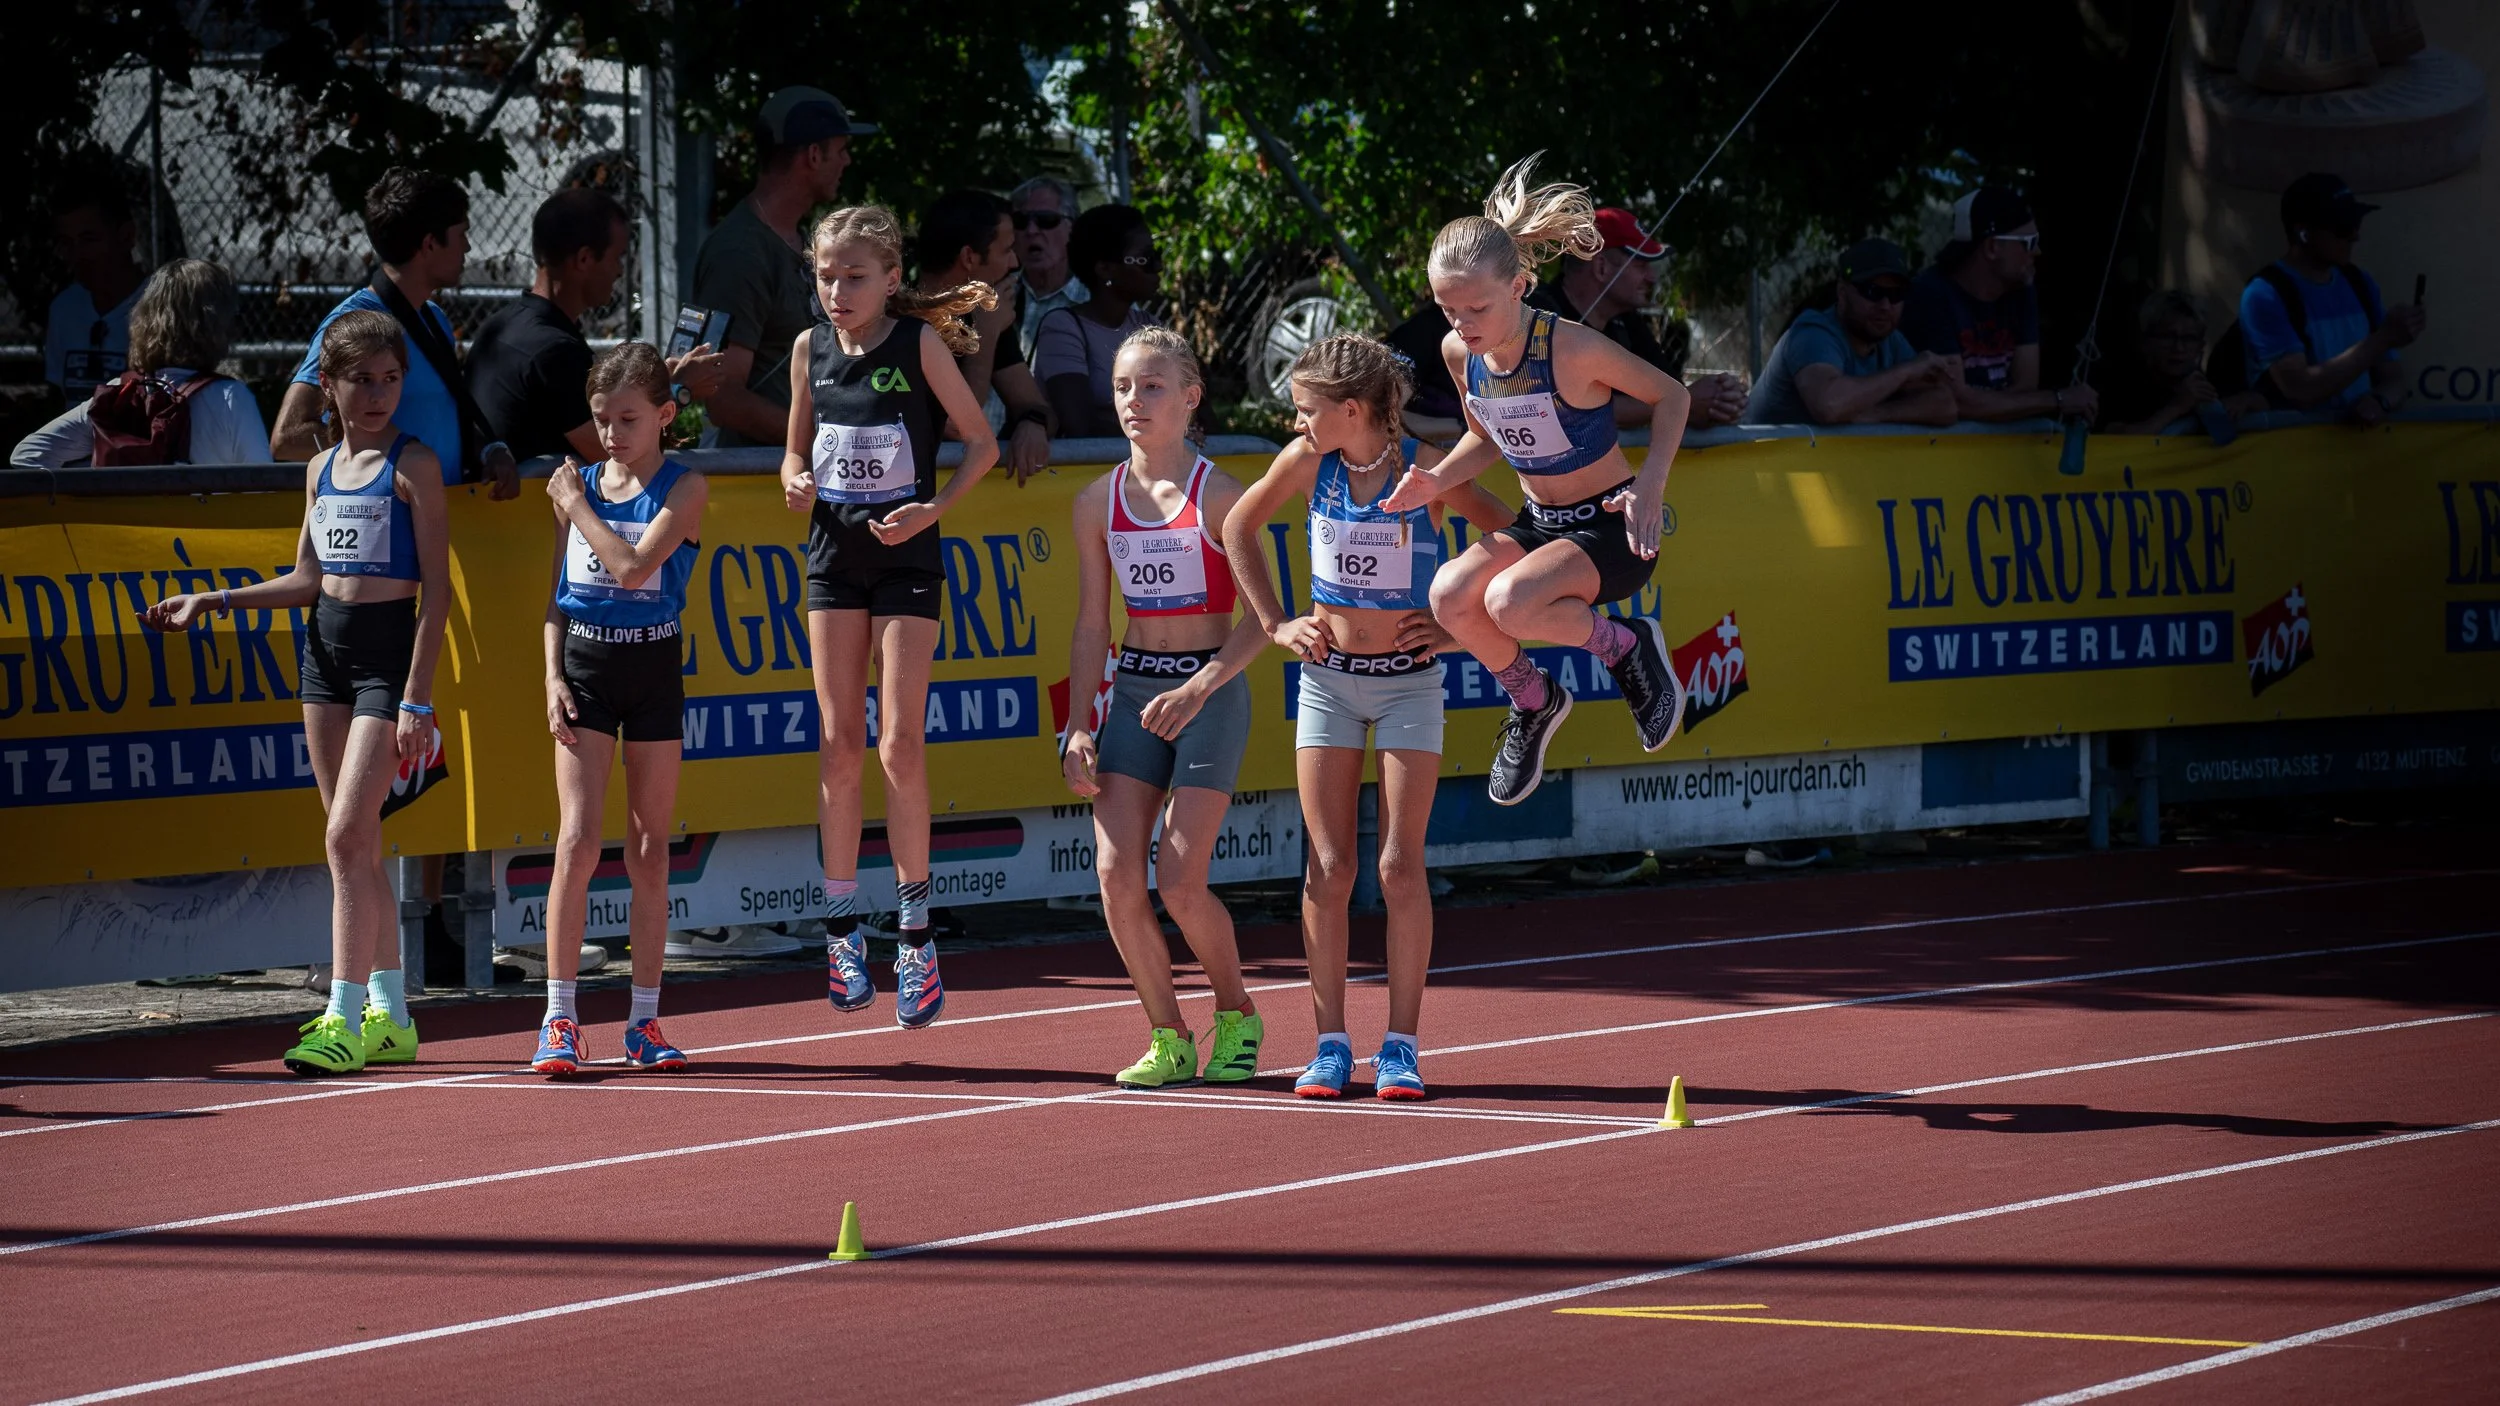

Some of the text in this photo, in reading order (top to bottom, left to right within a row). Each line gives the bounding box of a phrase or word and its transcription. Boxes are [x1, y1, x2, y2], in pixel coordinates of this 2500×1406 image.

[871, 366, 912, 393] CA
[2408, 365, 2500, 400] .co
[1496, 427, 1536, 447] 166
[836, 457, 885, 480] 336
[1543, 503, 1596, 525] PRO
[326, 528, 359, 549] 122
[1877, 465, 2236, 610] LE GRUYÈRE
[1129, 562, 1176, 585] 206
[1334, 552, 1378, 577] 162
[1340, 577, 1371, 587] KOHLER
[1905, 621, 2219, 673] SWITZERLAND
[2249, 616, 2312, 680] AOP
[1138, 656, 1200, 674] PRO
[1349, 654, 1414, 673] PRO
[1686, 646, 1745, 711] AOP
[2185, 754, 2320, 784] GWIDEMSTRASSE
[2322, 752, 2334, 775] 7
[2355, 749, 2391, 773] 4132
[2394, 745, 2468, 771] MUTTENZ
[1622, 755, 1866, 804] www.edm-jourdan.ch
